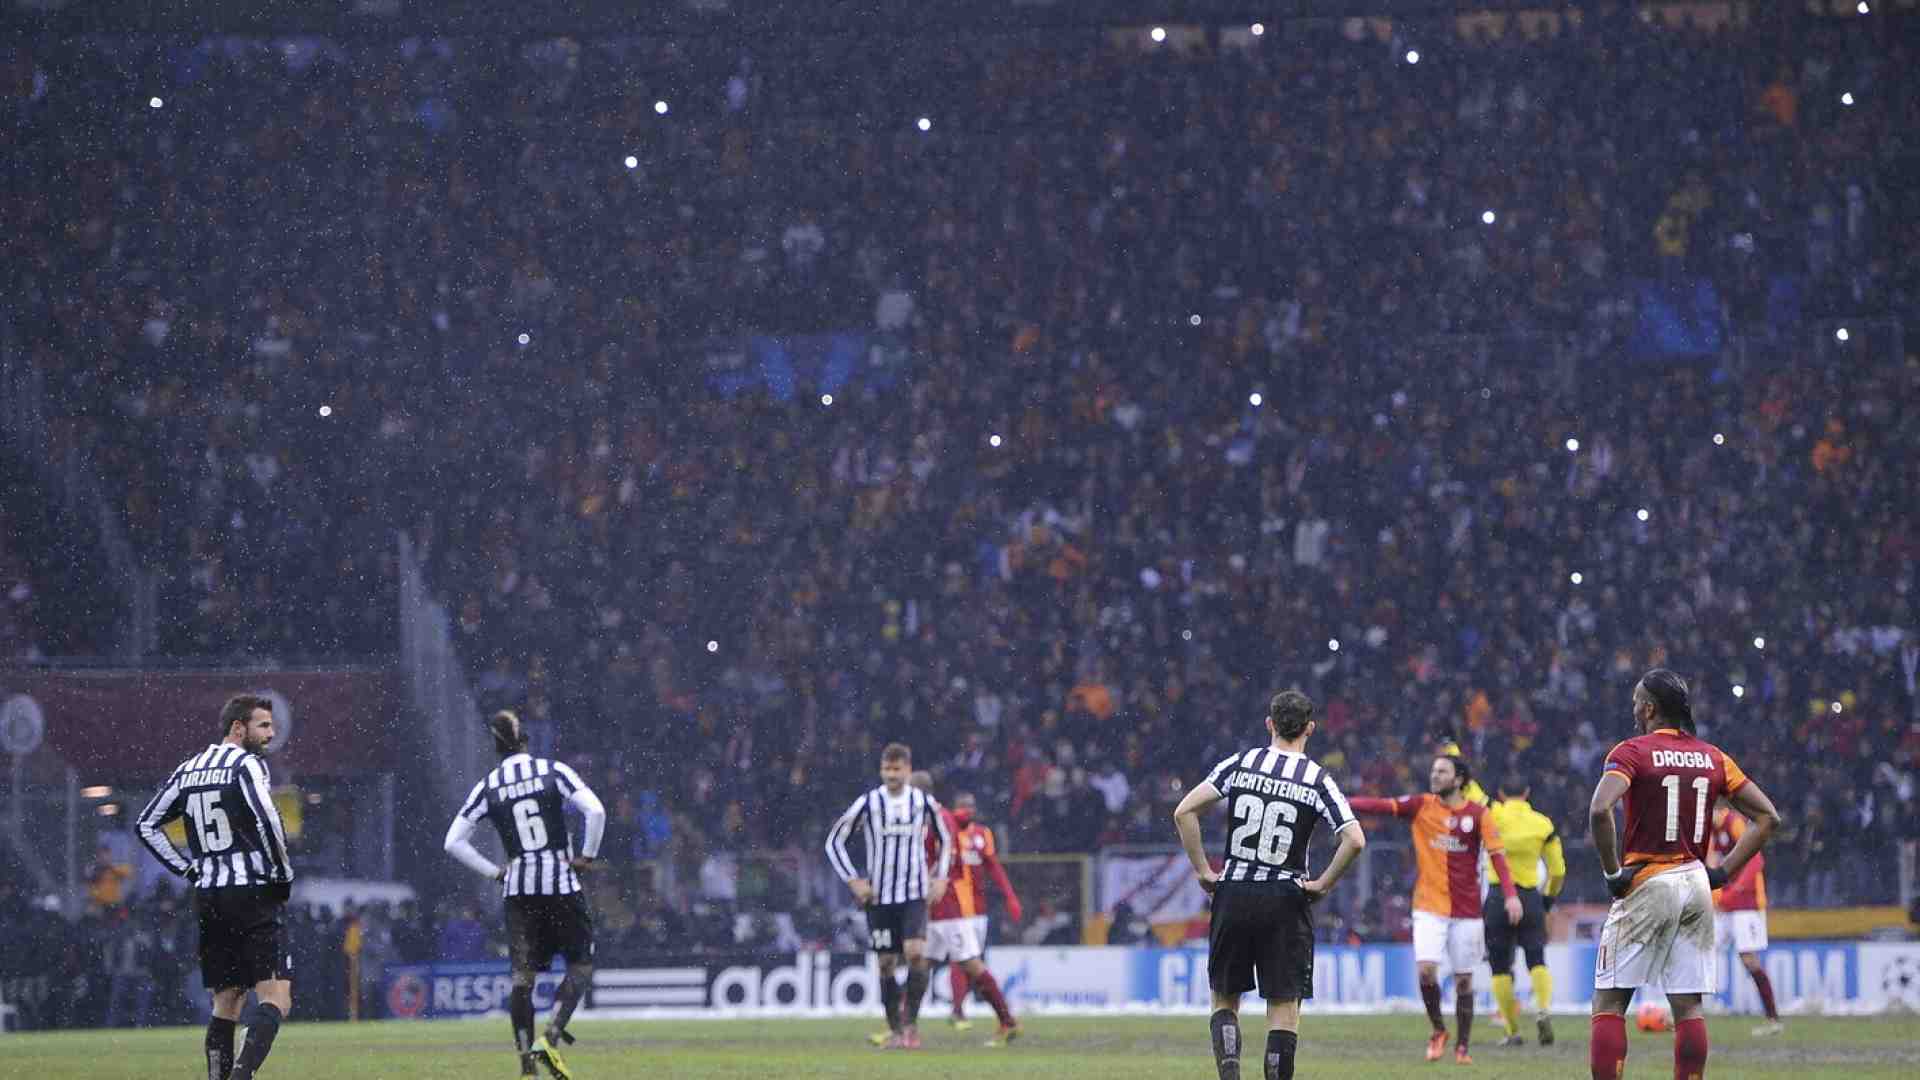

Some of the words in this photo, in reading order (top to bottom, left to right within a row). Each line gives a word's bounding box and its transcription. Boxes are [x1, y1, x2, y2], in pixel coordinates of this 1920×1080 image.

[1652, 751, 1714, 769] DROGBA
[186, 790, 233, 853] 15
[512, 798, 548, 851] 6
[1231, 794, 1297, 865] 26
[1661, 775, 1709, 843] 11
